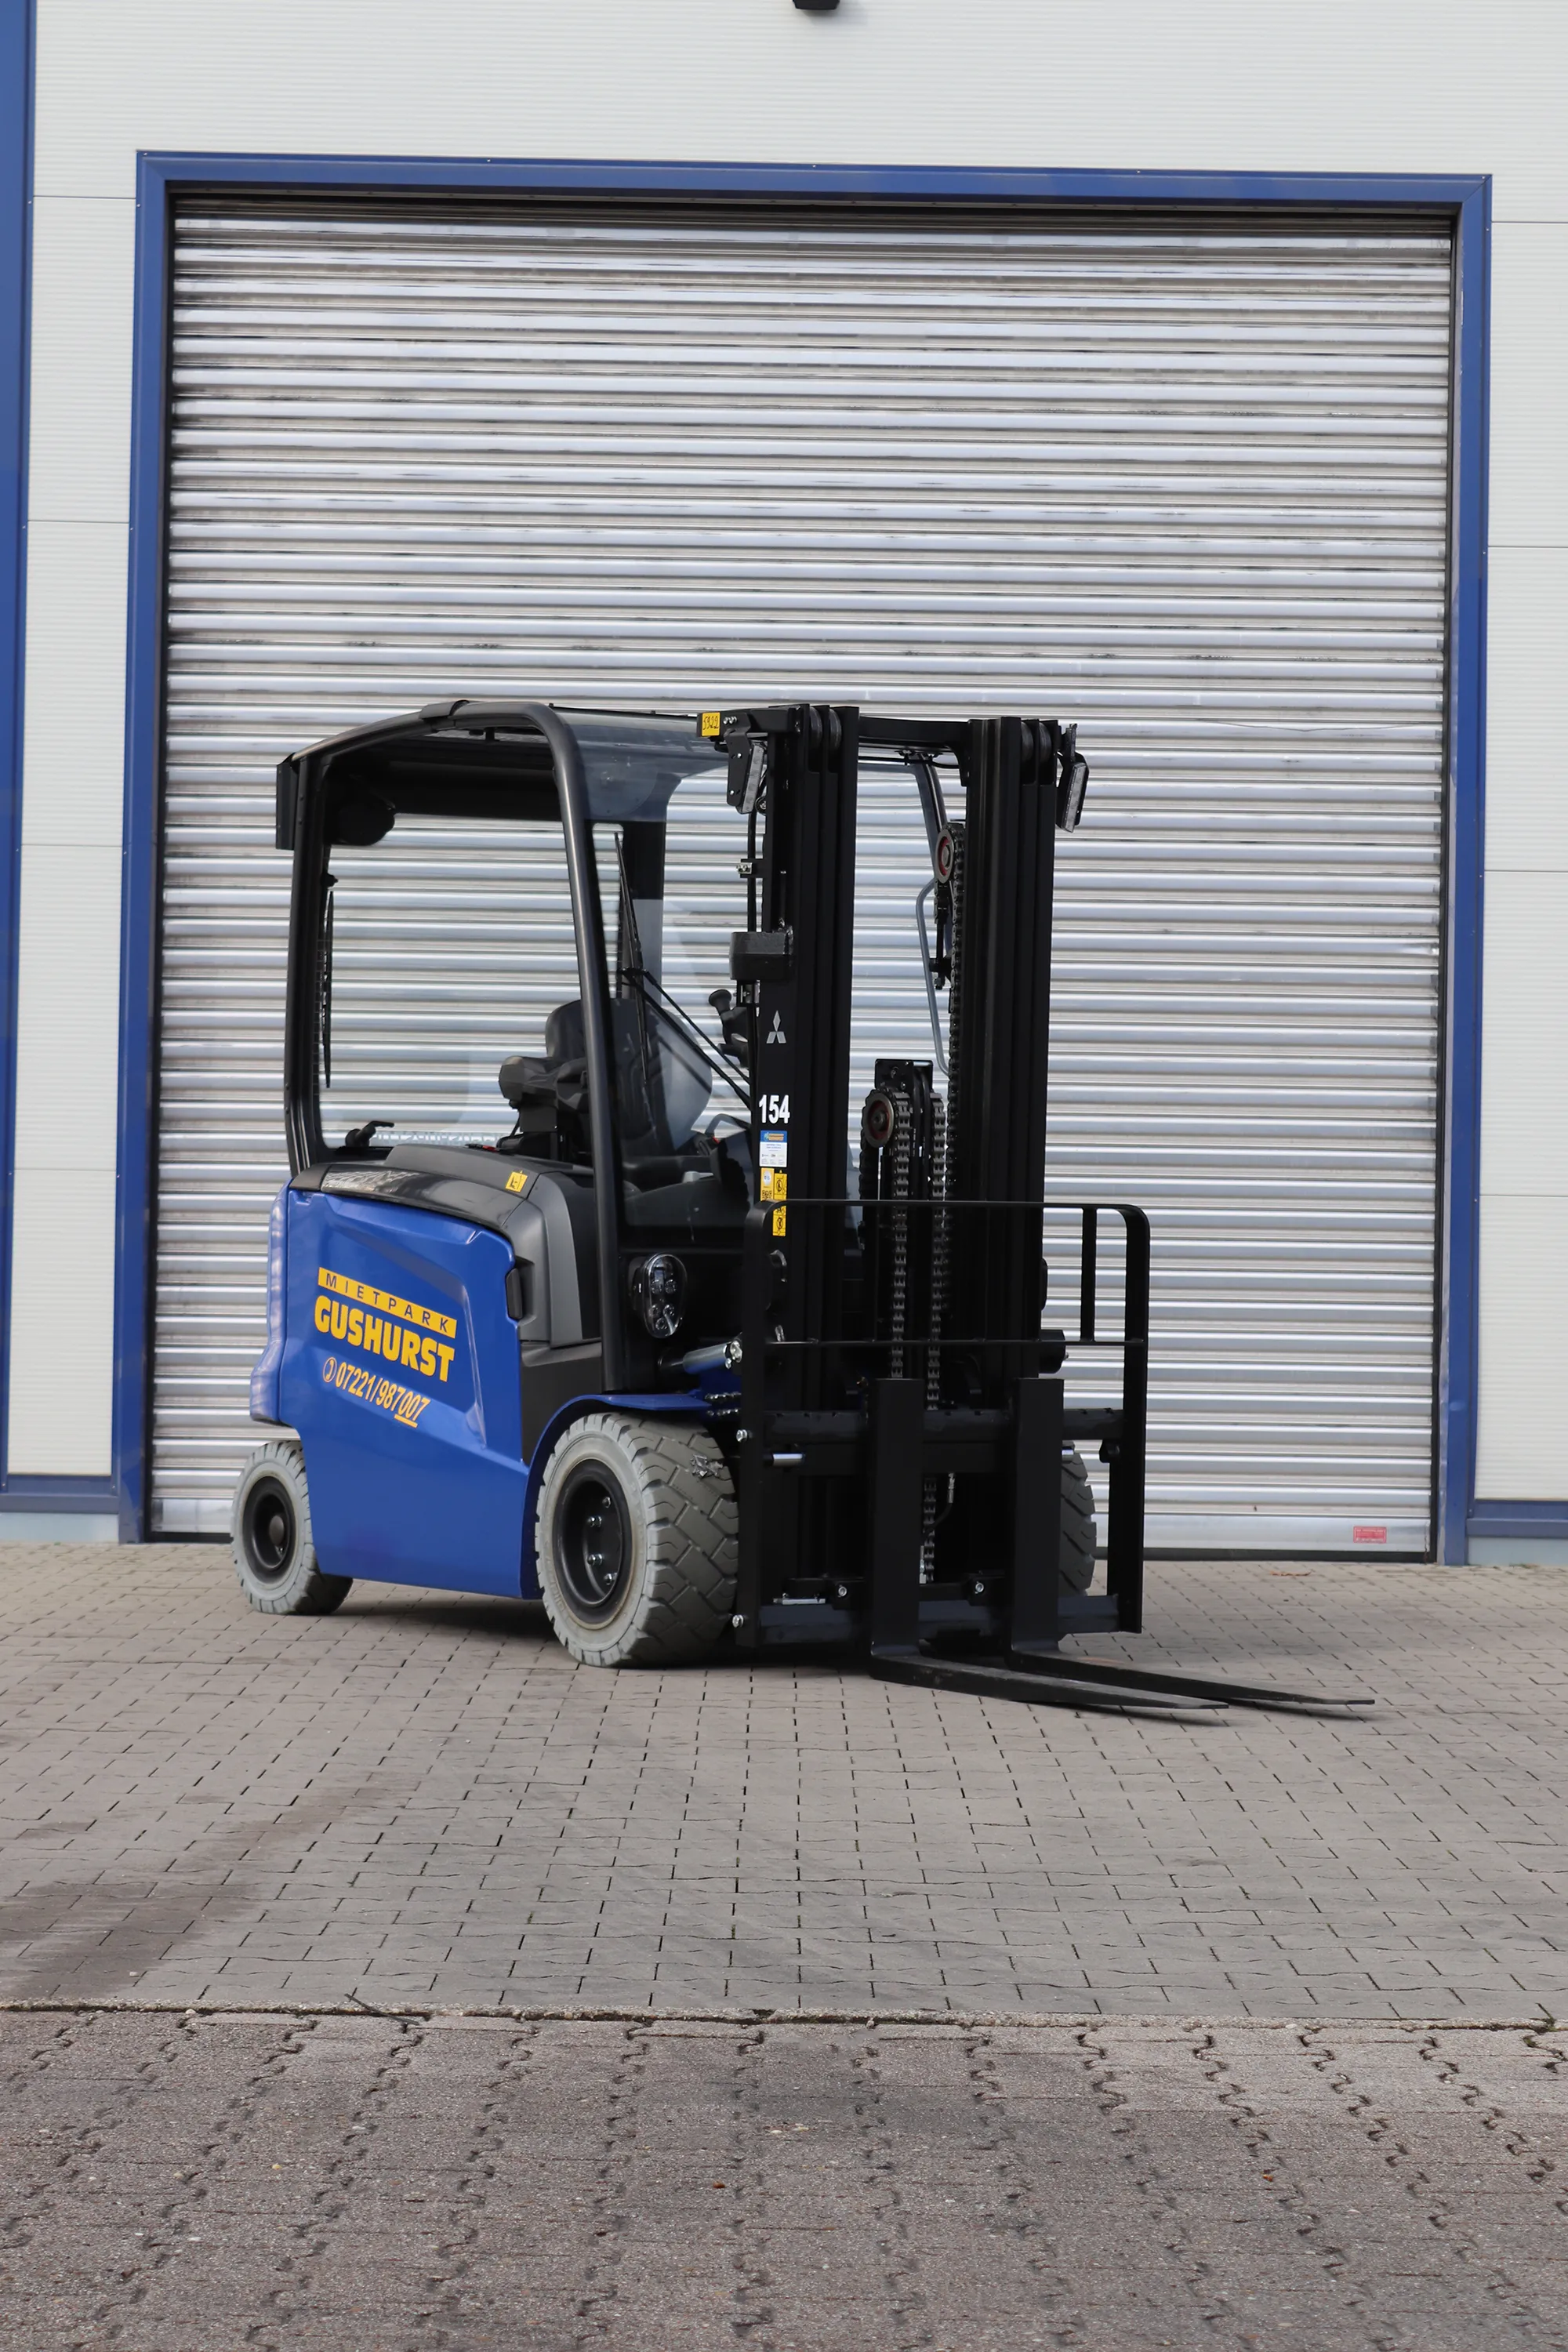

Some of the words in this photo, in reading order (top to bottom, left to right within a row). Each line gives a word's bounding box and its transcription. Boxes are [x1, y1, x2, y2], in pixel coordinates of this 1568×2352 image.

[759, 1094, 790, 1123] 154
[325, 1272, 448, 1333] MIETPARK
[314, 1294, 455, 1382] GUSHURST
[335, 1361, 431, 1424] 07221/987007
